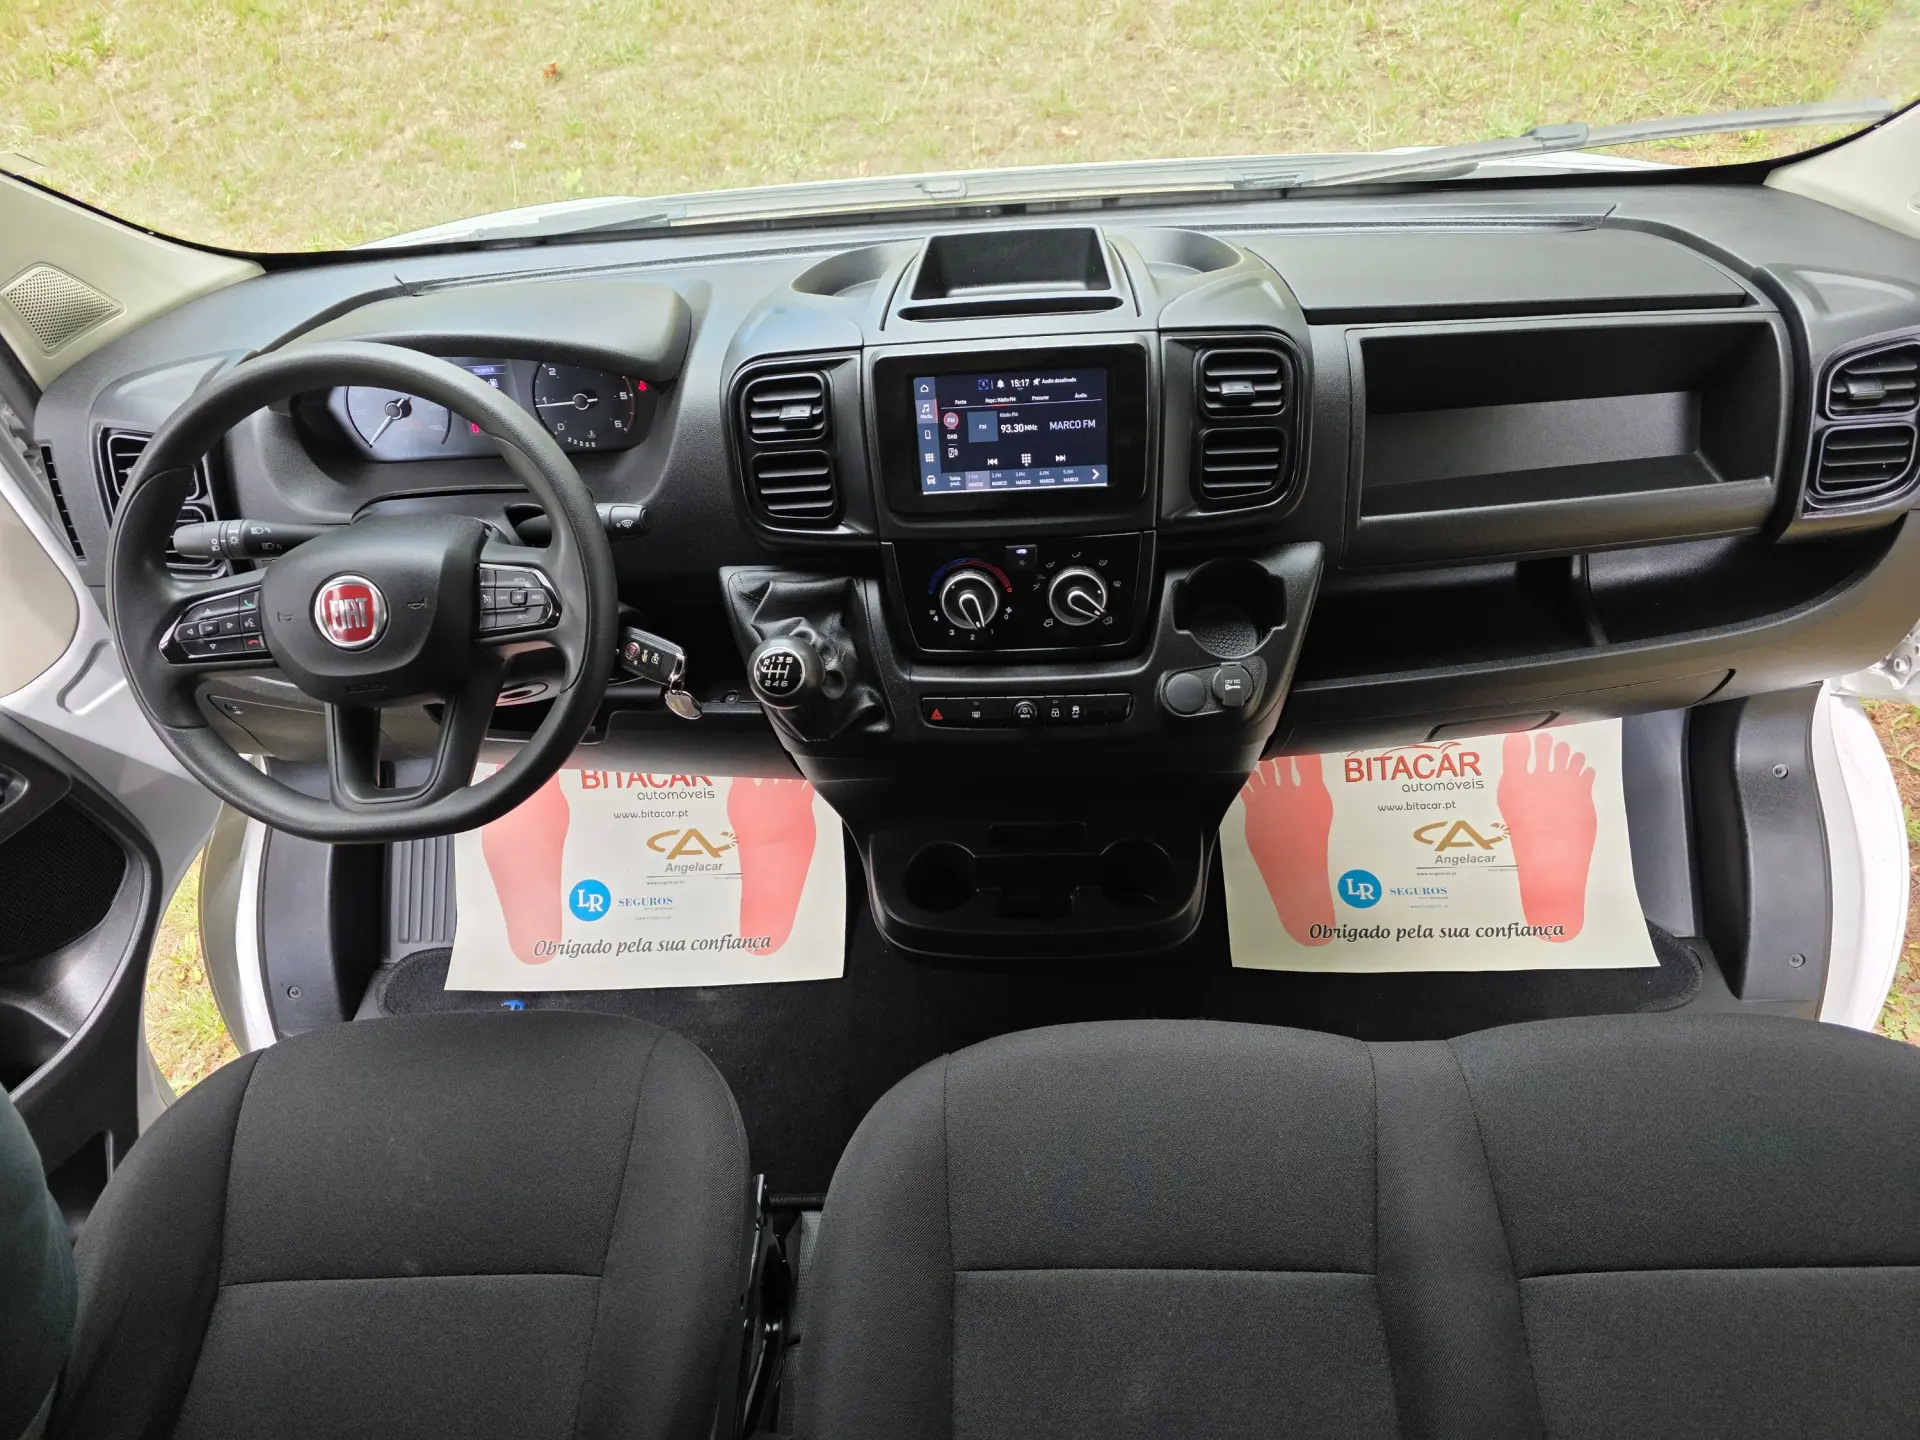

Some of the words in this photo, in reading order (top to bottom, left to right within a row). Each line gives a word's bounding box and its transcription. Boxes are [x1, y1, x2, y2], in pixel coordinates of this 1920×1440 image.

[548, 367, 556, 376] 2
[1011, 379, 1029, 387] 15:17
[619, 391, 627, 400] 5
[614, 420, 622, 428] 6
[1000, 424, 1024, 433] 93.30
[1049, 420, 1081, 430] MARCO
[1083, 419, 1096, 428] FM
[329, 598, 368, 630] FIAT
[1344, 751, 1482, 783] BITACAR
[1401, 778, 1485, 793] automóveis
[637, 788, 715, 801] automóveis
[1377, 800, 1456, 812] www.bitacar.pt
[613, 809, 689, 820] www.bitacar.pt
[1434, 853, 1497, 866] Angelacar
[664, 861, 724, 875] Angelacar
[1346, 878, 1375, 900] LR
[1389, 887, 1448, 896] SEGUROS
[577, 889, 603, 912] LR
[618, 897, 673, 907] SEGUROS
[1309, 923, 1391, 942] Obrigado
[1396, 924, 1435, 942] pela
[1439, 926, 1470, 939] sua
[1476, 922, 1565, 940] confiança
[533, 938, 612, 959] Obrigado
[616, 937, 653, 957] pela
[656, 938, 686, 952] sua
[690, 933, 771, 953] confiança
